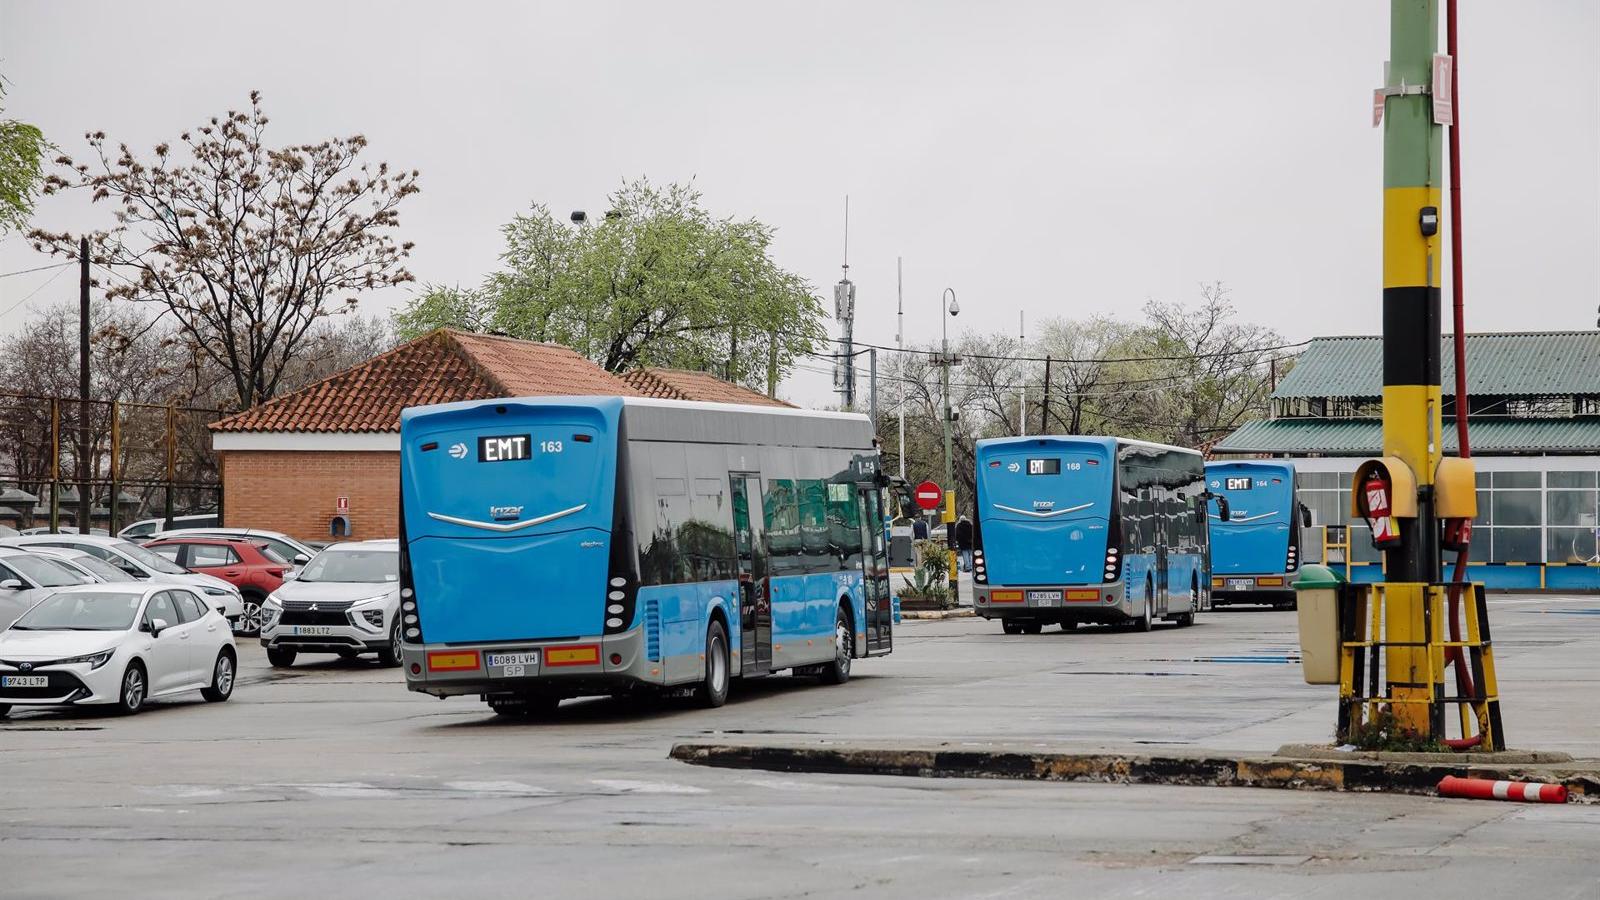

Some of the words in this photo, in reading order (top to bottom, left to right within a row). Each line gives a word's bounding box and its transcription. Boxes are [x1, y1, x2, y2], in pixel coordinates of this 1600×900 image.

[485, 437, 525, 461] EMT
[540, 441, 562, 453] 163
[1030, 459, 1044, 474] EMT
[1228, 478, 1249, 489] EMT
[494, 655, 516, 665] 6089
[518, 654, 536, 664] LVH
[7, 677, 28, 686] 9743
[29, 677, 46, 686] LTP
